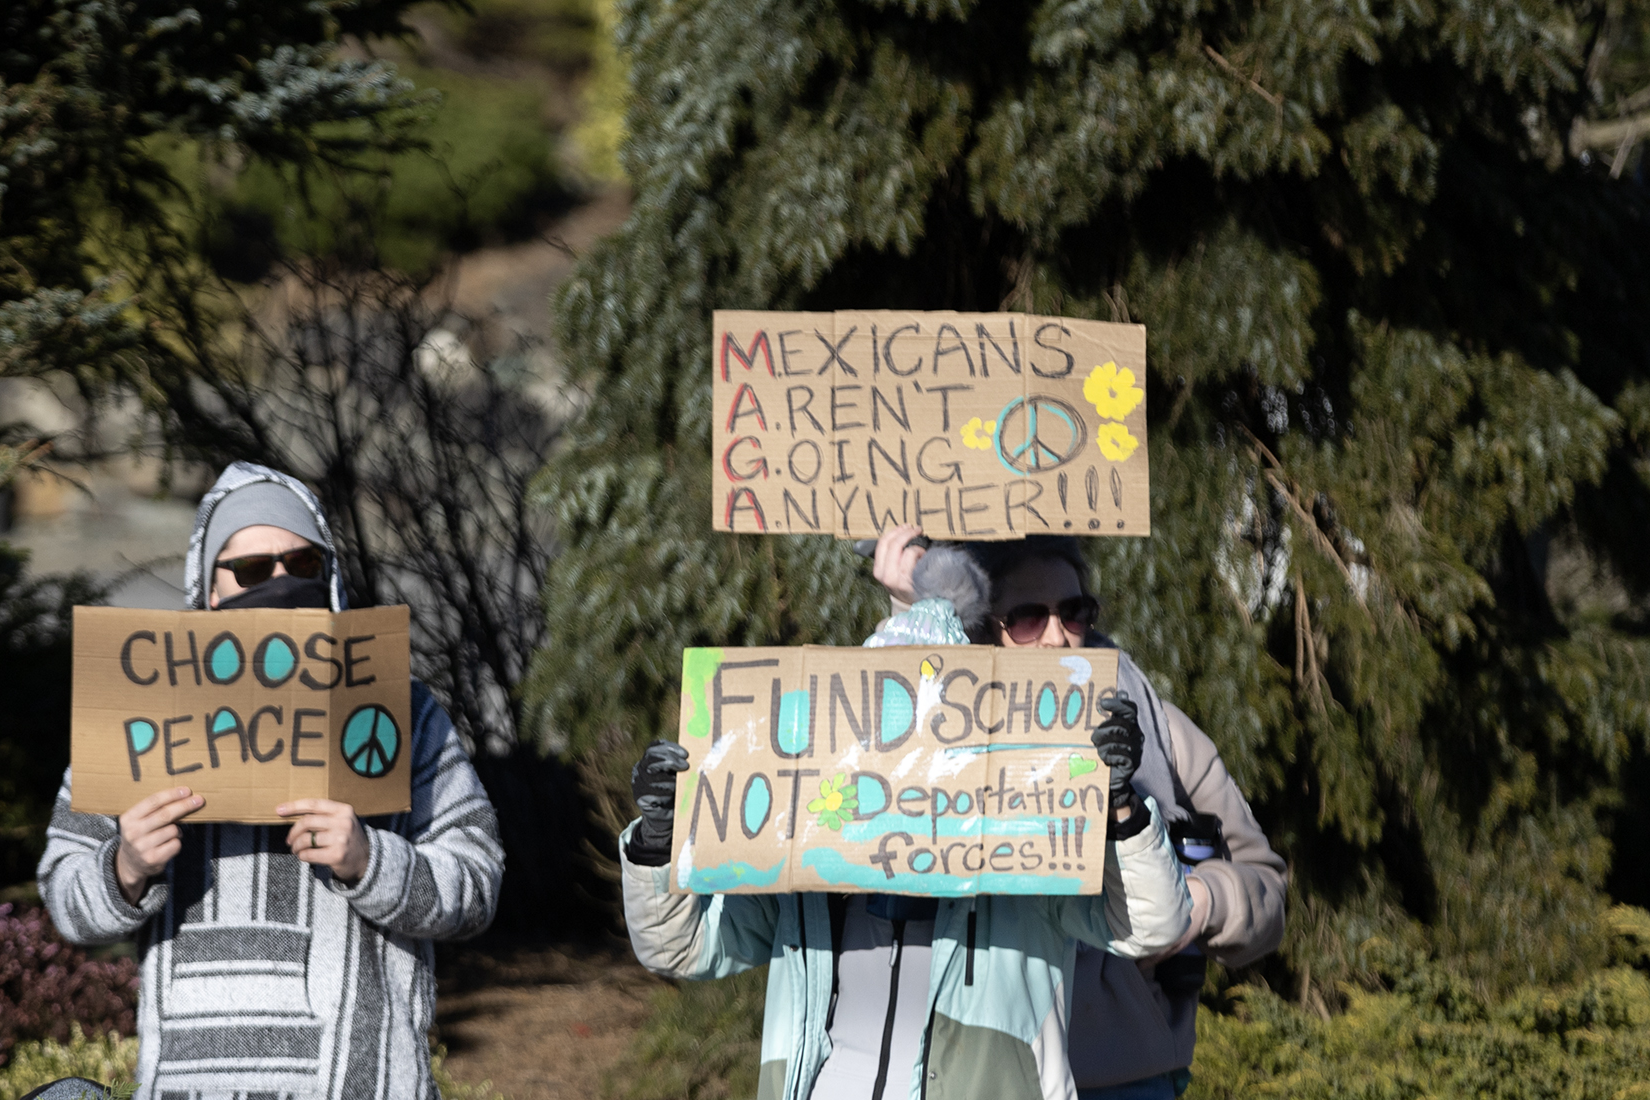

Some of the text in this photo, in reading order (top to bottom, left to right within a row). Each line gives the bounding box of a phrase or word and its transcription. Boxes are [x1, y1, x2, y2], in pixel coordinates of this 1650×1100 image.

[120, 629, 377, 690] CHOOSE
[123, 704, 327, 782] PEACE
[712, 658, 918, 760] FUND
[689, 767, 1105, 845] NOT Deportation
[870, 816, 1087, 880] forces!!!
